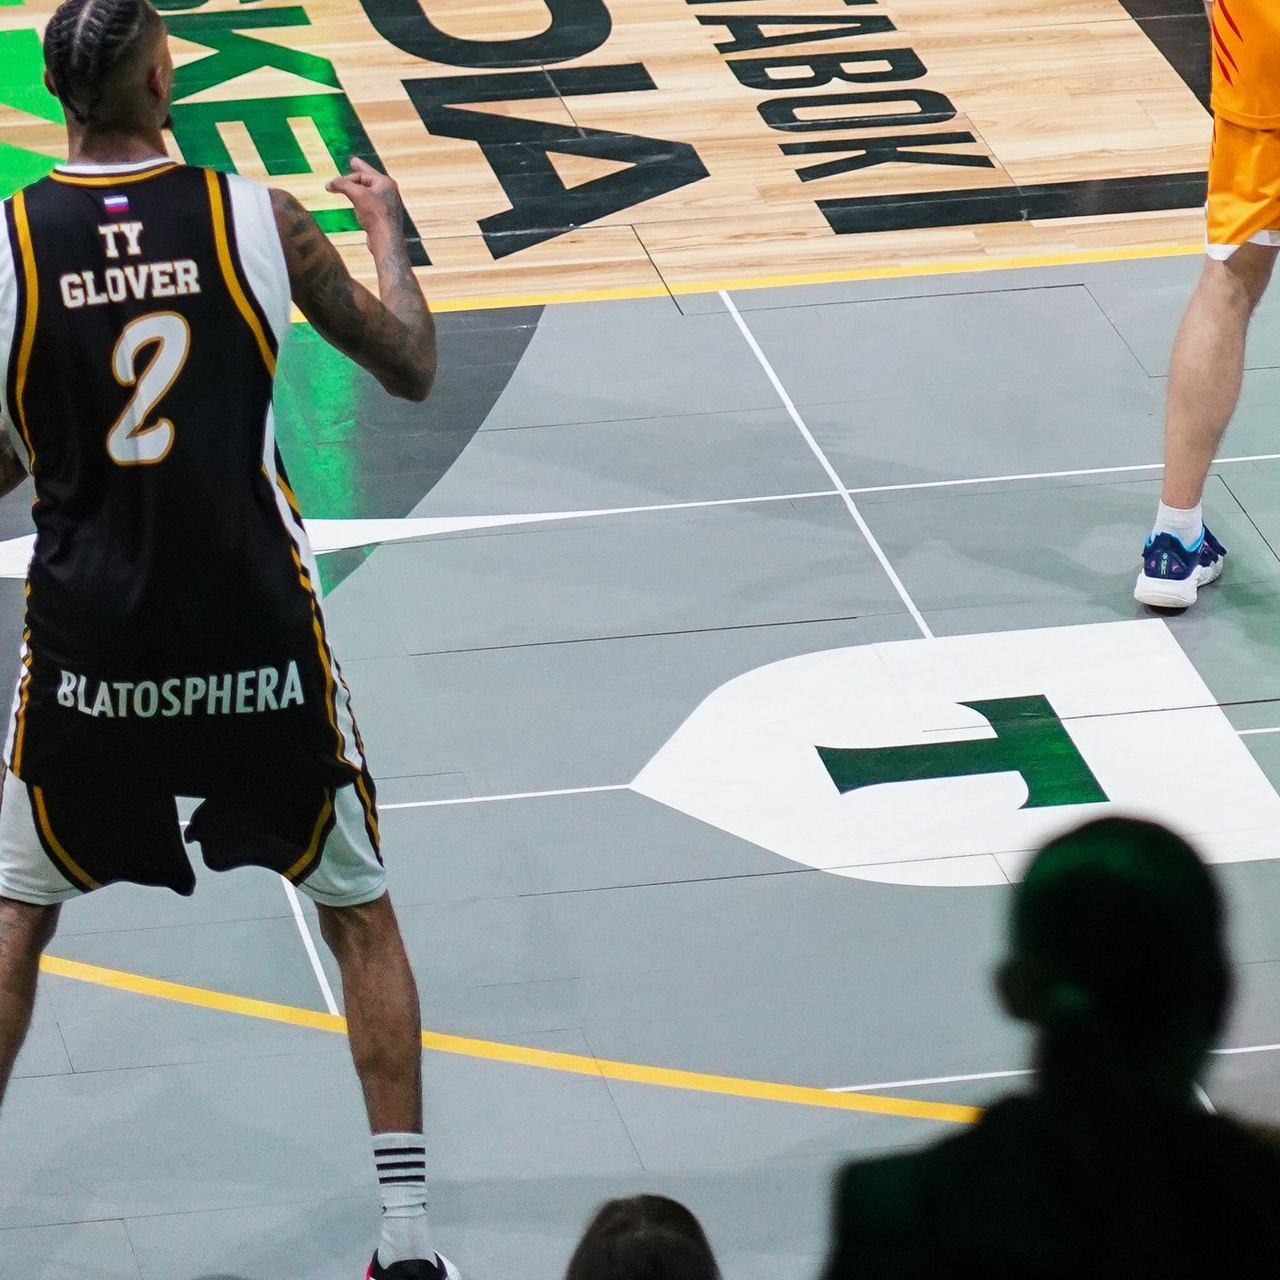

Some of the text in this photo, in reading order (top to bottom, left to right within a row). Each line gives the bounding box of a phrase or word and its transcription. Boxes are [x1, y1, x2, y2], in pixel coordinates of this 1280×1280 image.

[98, 222, 144, 259] TY
[59, 259, 202, 309] GLOVER
[105, 311, 191, 466] 2
[56, 660, 306, 718] BLATOSPHERA
